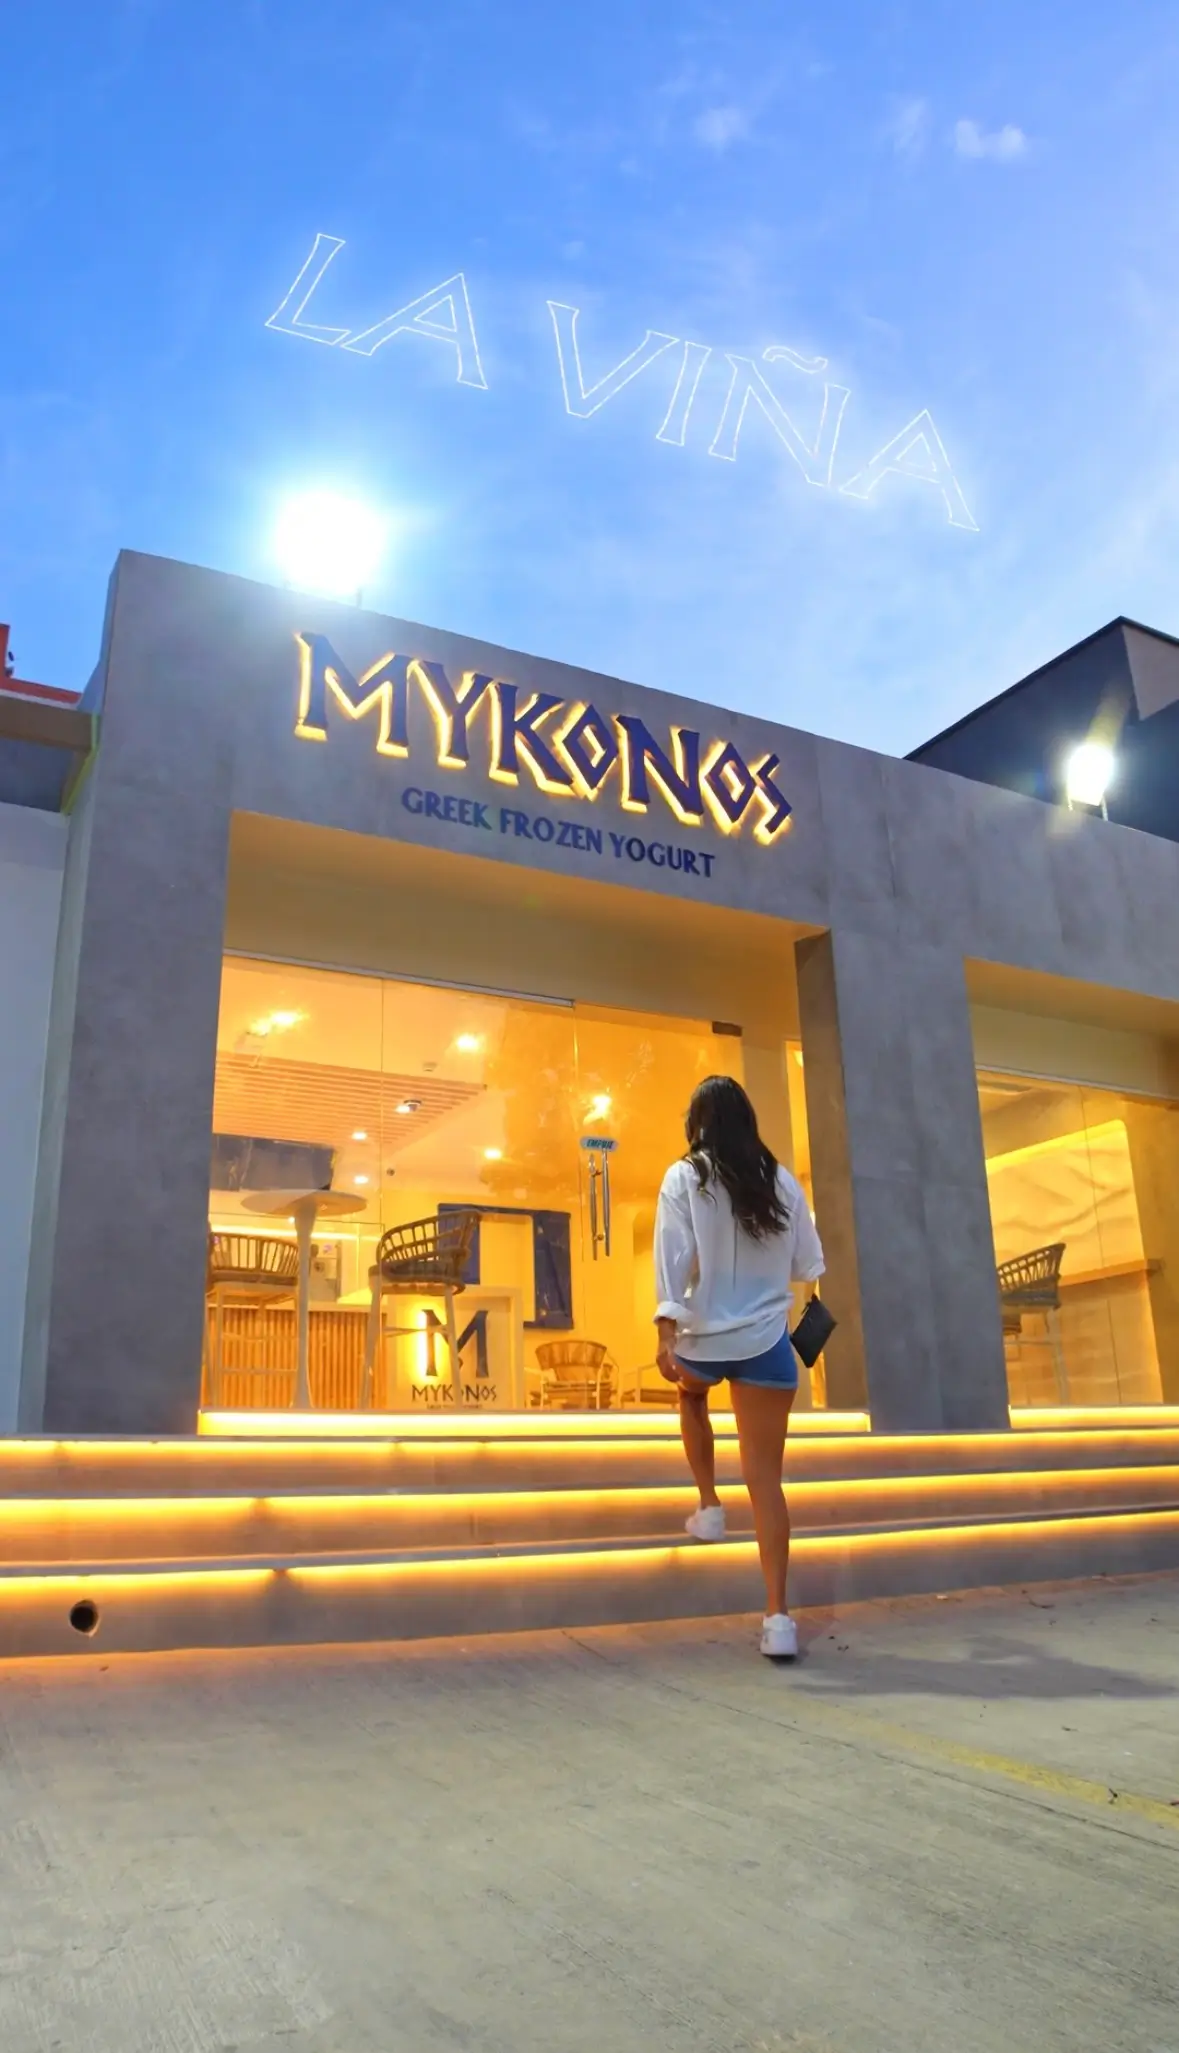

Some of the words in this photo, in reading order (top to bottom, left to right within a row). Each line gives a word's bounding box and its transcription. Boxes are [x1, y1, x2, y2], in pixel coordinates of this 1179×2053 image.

[293, 631, 793, 846] MYKONOS
[401, 786, 492, 831] GREEK
[500, 807, 603, 855] FROZEN
[608, 831, 716, 879] YOGURT
[411, 1383, 497, 1402] MYKNOS
